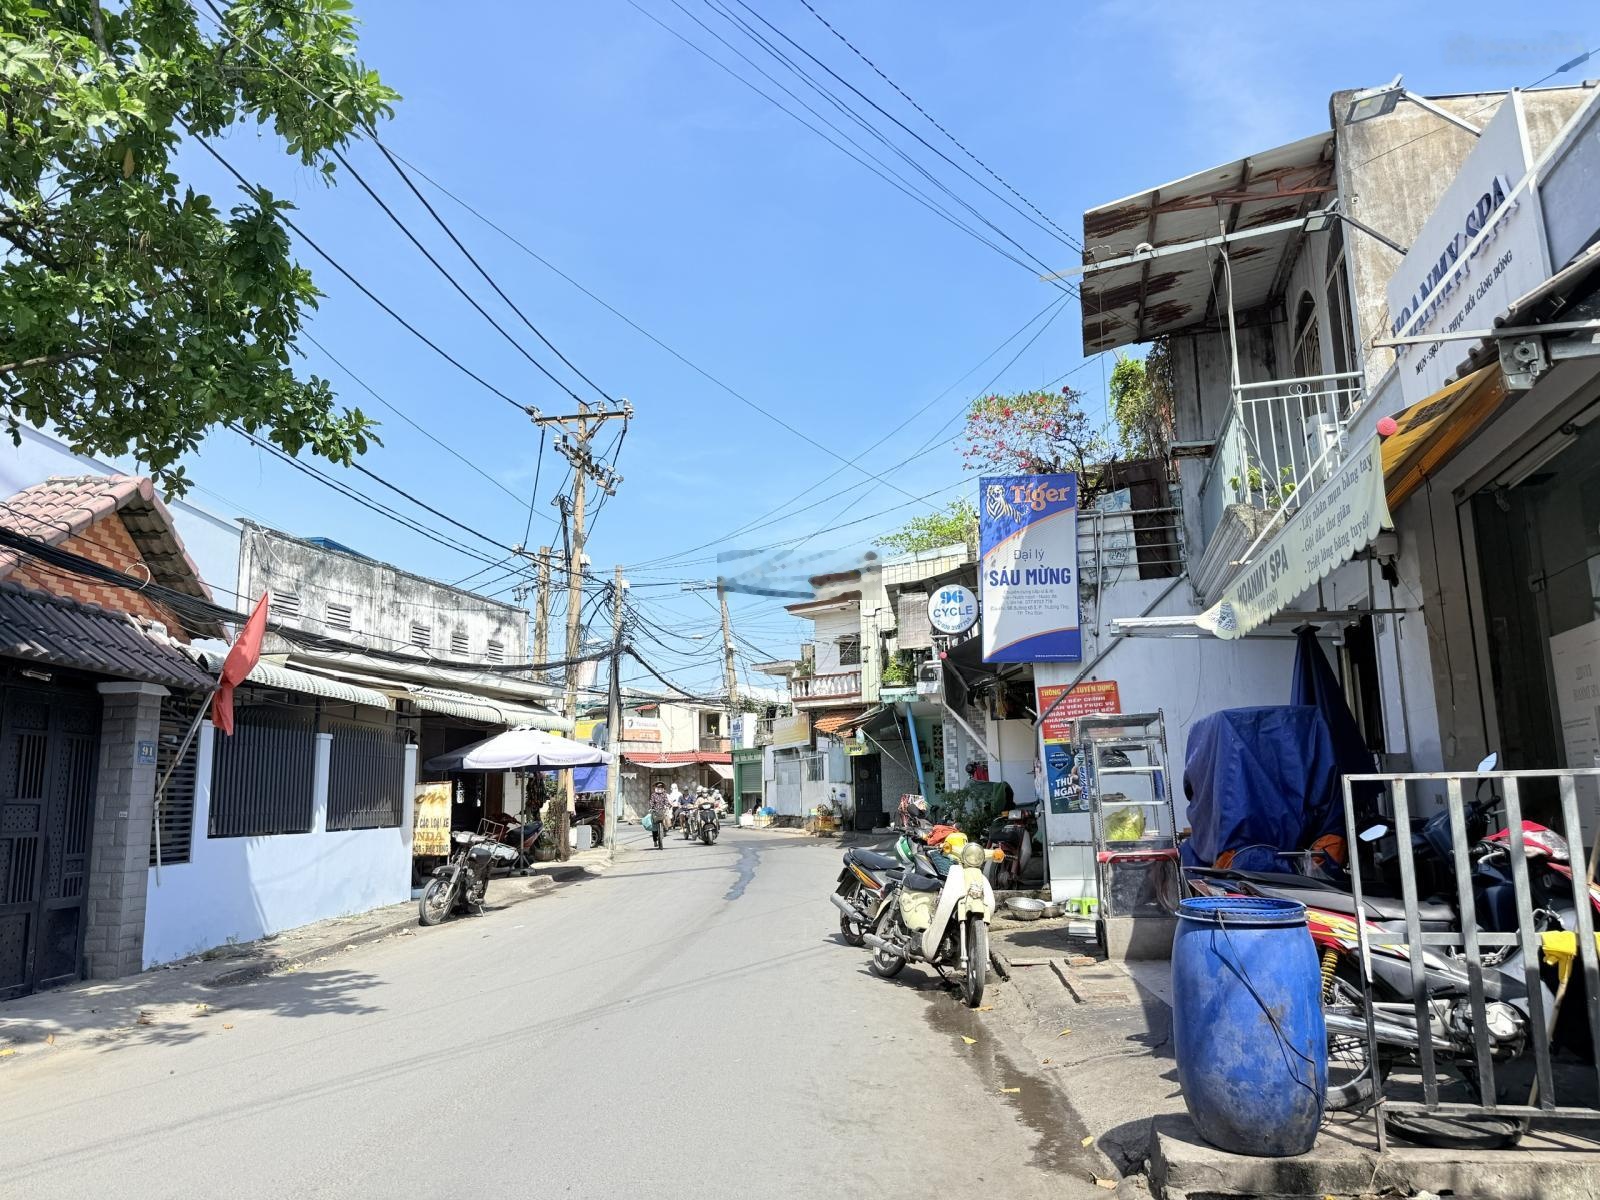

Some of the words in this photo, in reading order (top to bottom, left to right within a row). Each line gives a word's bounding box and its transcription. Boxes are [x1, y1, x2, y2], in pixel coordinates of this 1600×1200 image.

[1359, 453, 1373, 472] tay
[1010, 482, 1071, 512] Tiger
[1014, 549, 1032, 562] Đại
[1035, 548, 1045, 562] lý
[989, 566, 1021, 587] SÁU
[1025, 564, 1071, 586] MỪNG
[1237, 559, 1268, 607] HOANMY
[1269, 543, 1289, 583] SPA
[940, 590, 964, 605] 96
[933, 604, 973, 618] CYCLE
[1041, 688, 1062, 697] THÔNG
[142, 745, 153, 756] 91
[1053, 785, 1078, 798] NGAY
